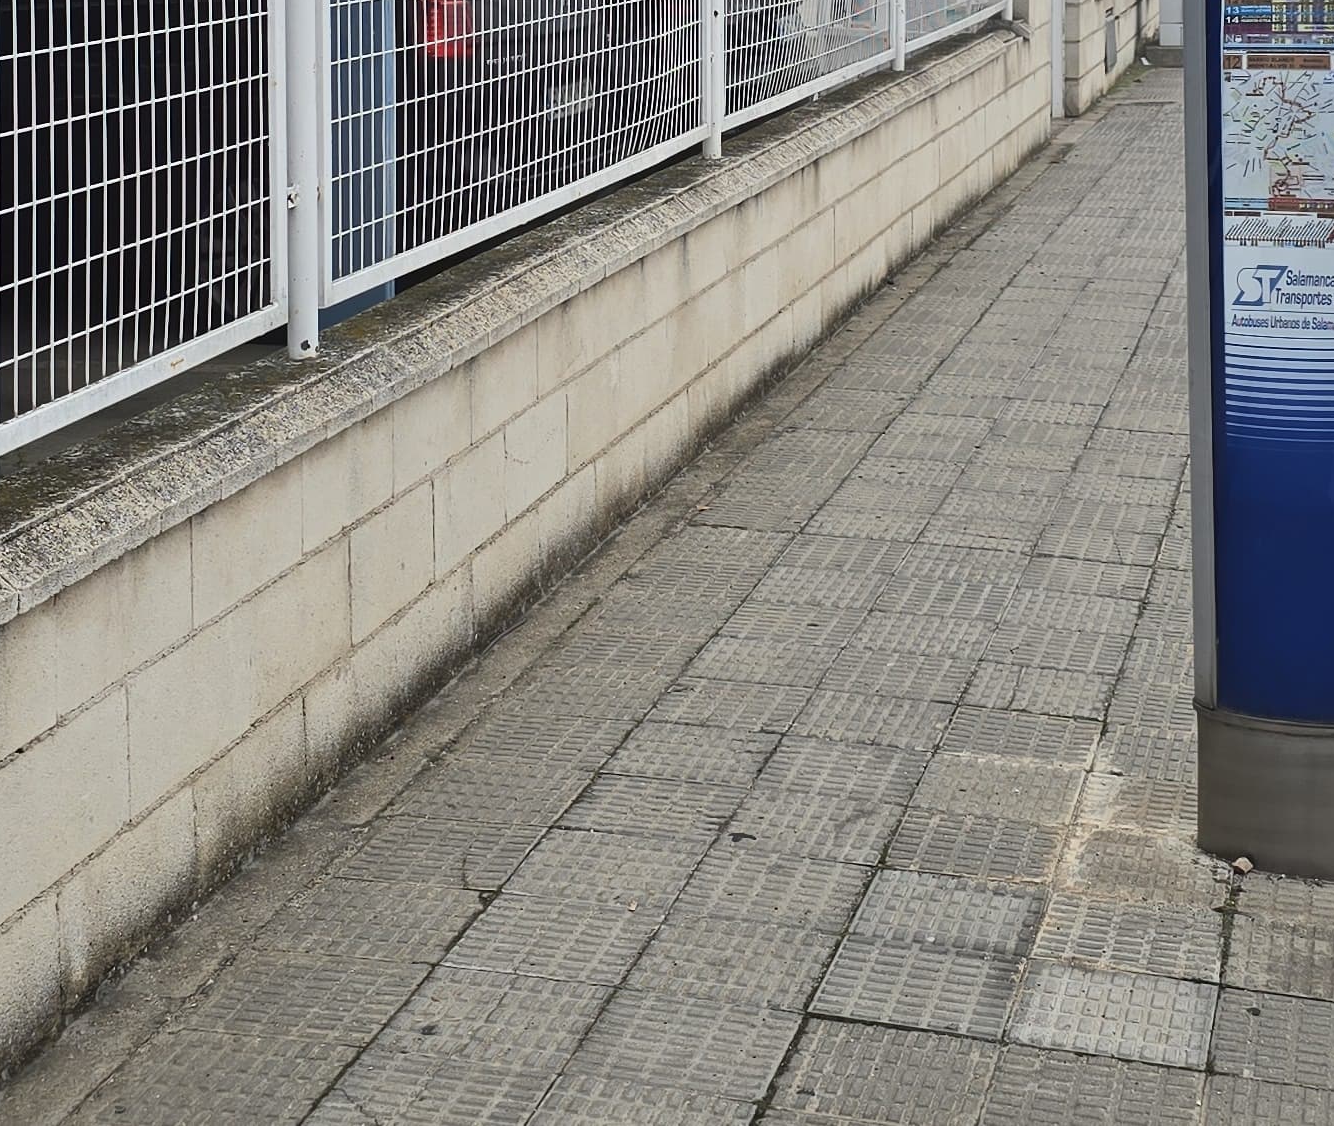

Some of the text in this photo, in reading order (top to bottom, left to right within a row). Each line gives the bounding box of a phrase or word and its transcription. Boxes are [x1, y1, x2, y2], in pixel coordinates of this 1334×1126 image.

[1275, 287, 1333, 309] Transportes
[1231, 314, 1269, 328] Autobuses
[1270, 315, 1300, 330] Urbanos
[1301, 317, 1311, 330] de
